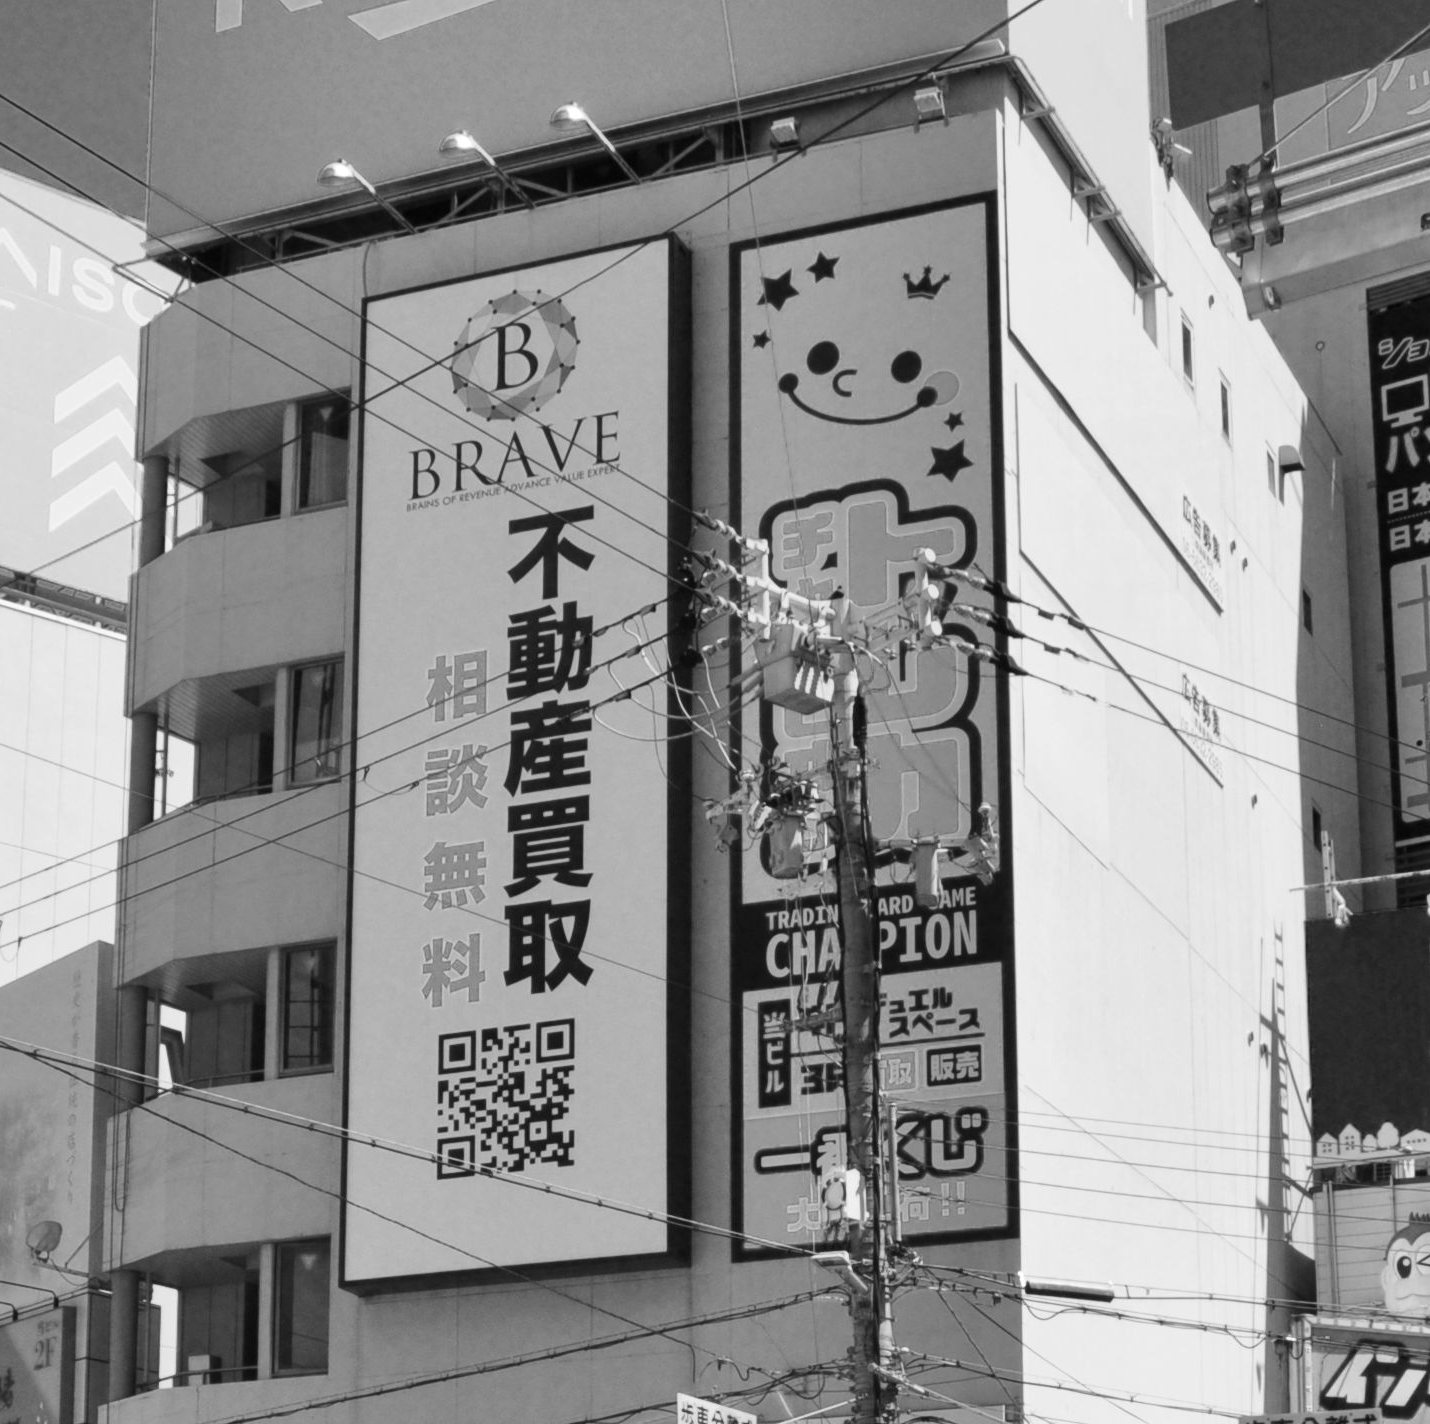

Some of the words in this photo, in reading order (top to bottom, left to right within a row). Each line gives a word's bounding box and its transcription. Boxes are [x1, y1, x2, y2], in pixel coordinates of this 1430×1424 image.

[409, 410, 621, 501] BRAVE
[406, 497, 440, 512] BRAINS
[442, 494, 457, 506] OF
[459, 487, 502, 503] REVENUE
[504, 476, 551, 494] ADVANCE
[553, 469, 585, 484] VALUE
[586, 462, 622, 479] EXPERT
[503, 505, 596, 994] 不動産買取
[421, 649, 490, 1008] 相談無料
[766, 904, 841, 930] TRADIN
[877, 894, 913, 916] ARD
[765, 909, 978, 979] CHAPION
[888, 1007, 980, 1039] スペース
[930, 1050, 980, 1082] 販売
